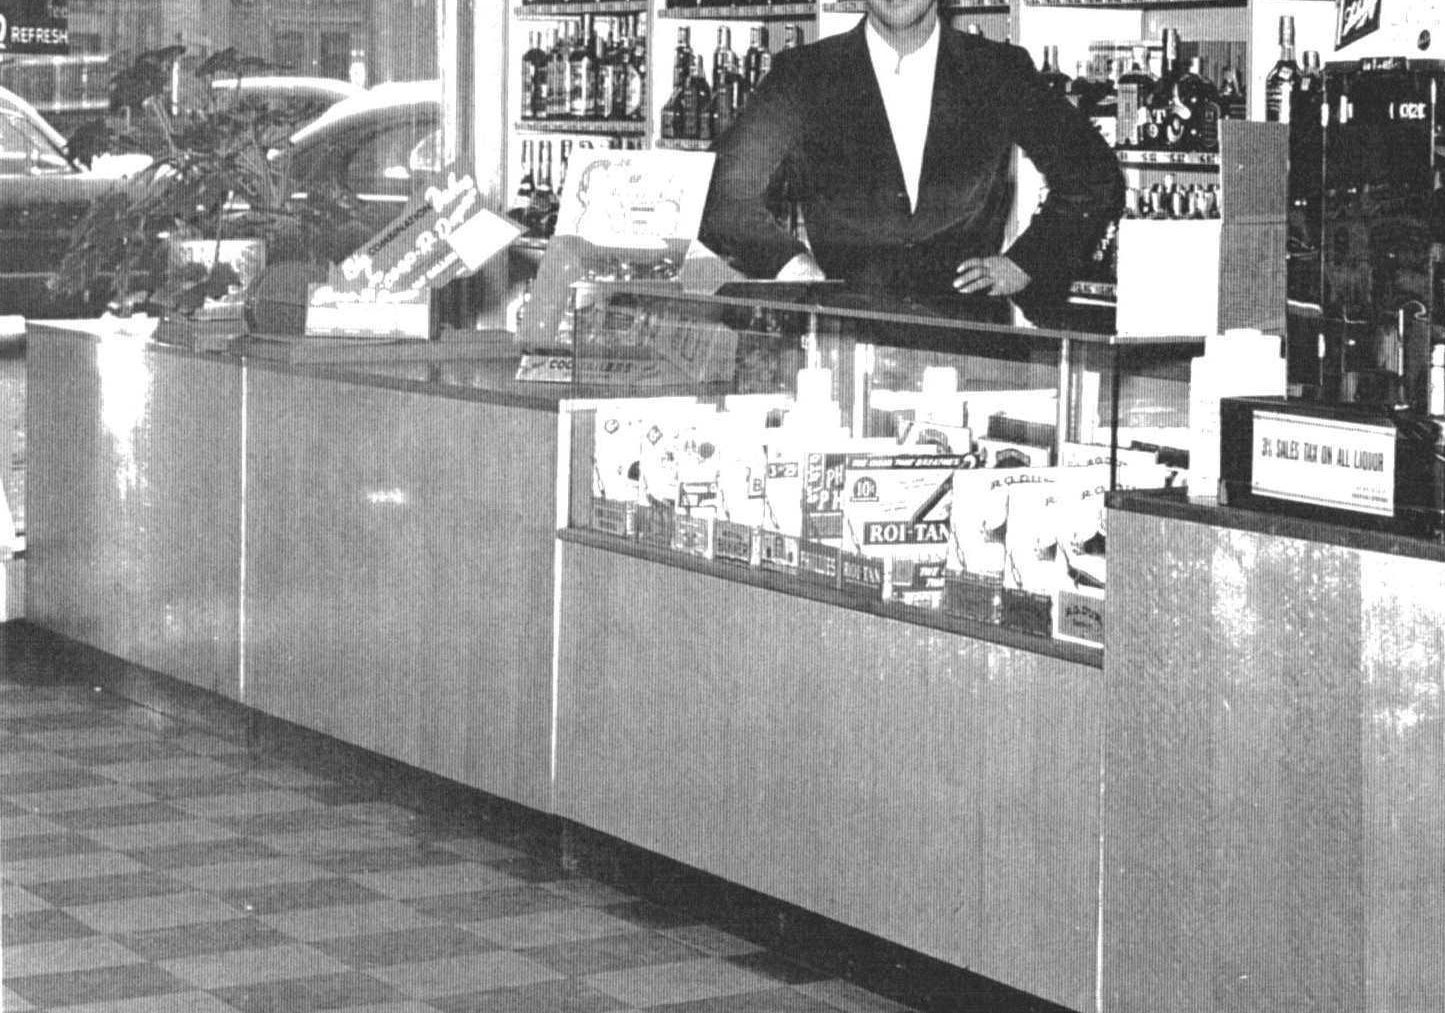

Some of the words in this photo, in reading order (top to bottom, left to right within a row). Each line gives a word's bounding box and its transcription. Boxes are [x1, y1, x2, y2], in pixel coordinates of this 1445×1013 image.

[11, 26, 69, 44] REFRESH
[1276, 438, 1300, 461] SALES
[1303, 442, 1318, 463] TAX
[1321, 445, 1333, 465] ON
[1336, 447, 1351, 468] ALL
[1353, 448, 1384, 472] LIQUOR
[869, 522, 950, 543] ROI-TAN
